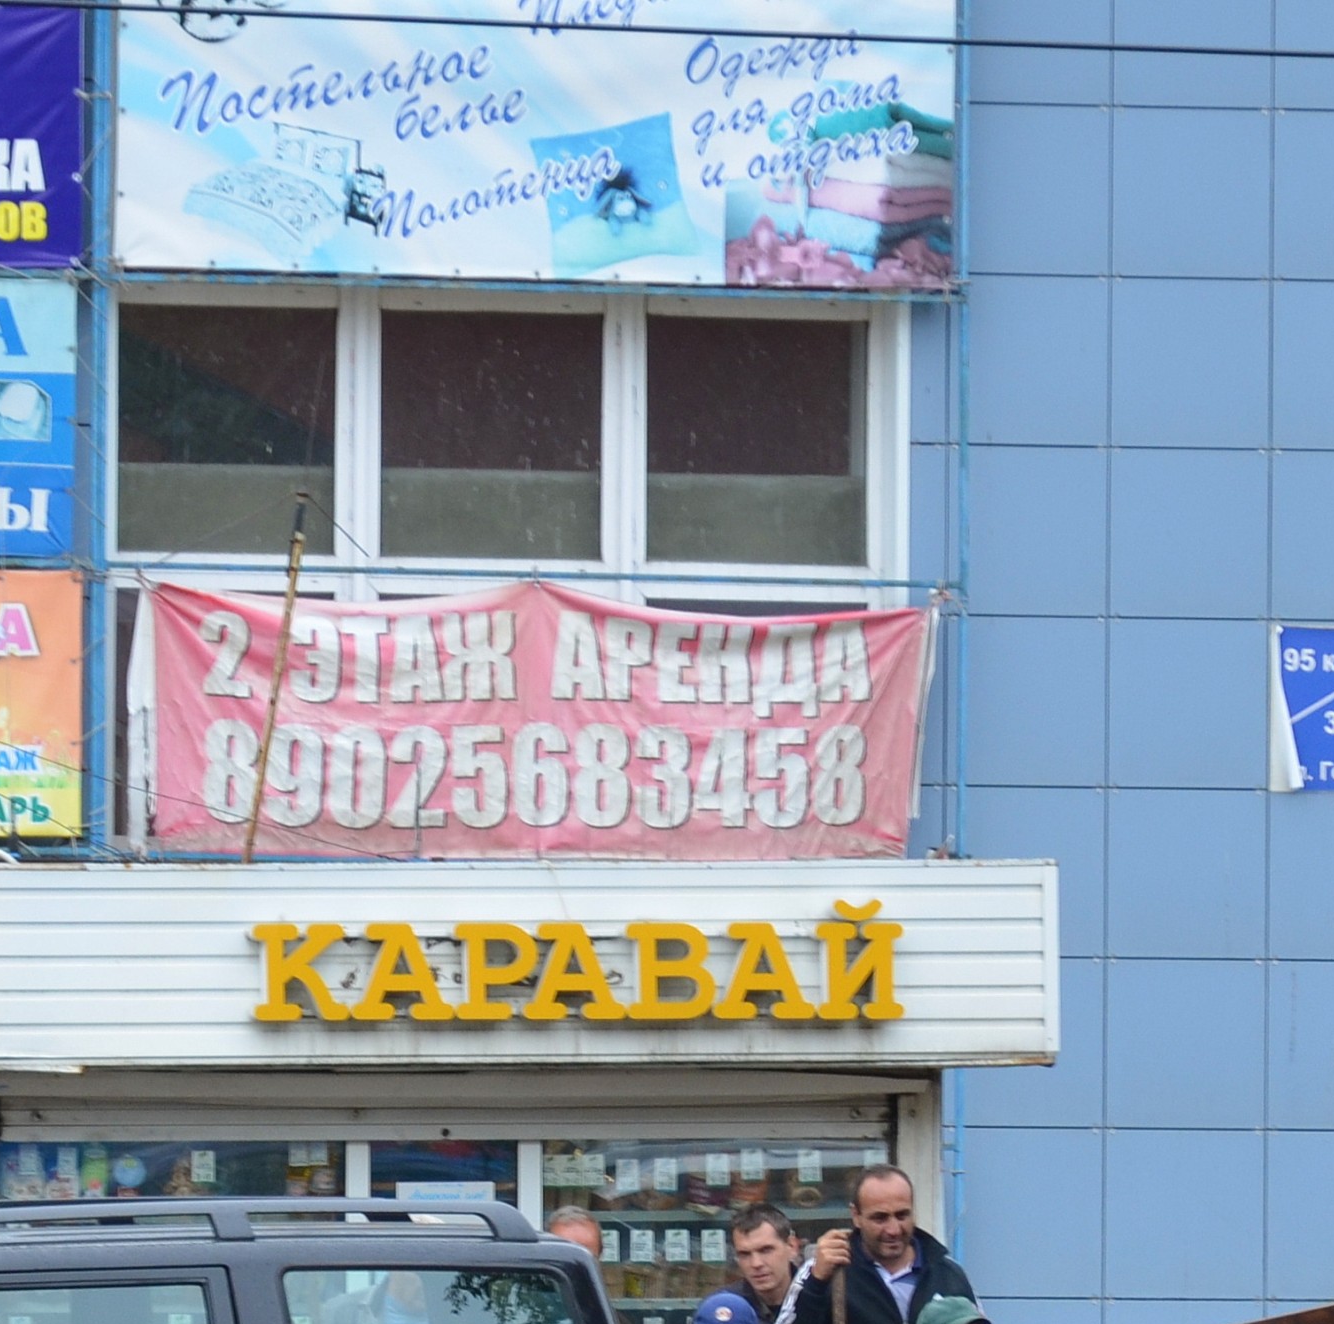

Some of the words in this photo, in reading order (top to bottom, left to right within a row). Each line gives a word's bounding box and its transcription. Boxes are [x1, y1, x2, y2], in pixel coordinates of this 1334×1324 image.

[160, 36, 496, 135] Постельное
[685, 28, 864, 97] Одежда
[394, 83, 527, 144] белье
[691, 102, 770, 157] для
[788, 70, 906, 131] дома
[699, 161, 732, 189] и
[746, 118, 919, 184] отдыха
[376, 144, 621, 241] Полотенца
[199, 609, 254, 700] 2
[290, 610, 520, 707] ЭТАЖ
[550, 609, 873, 719] АРЕНДА
[1283, 648, 1316, 673] 95
[201, 718, 869, 831] 89025683458
[251, 896, 906, 1024] КАРАВАЙ
